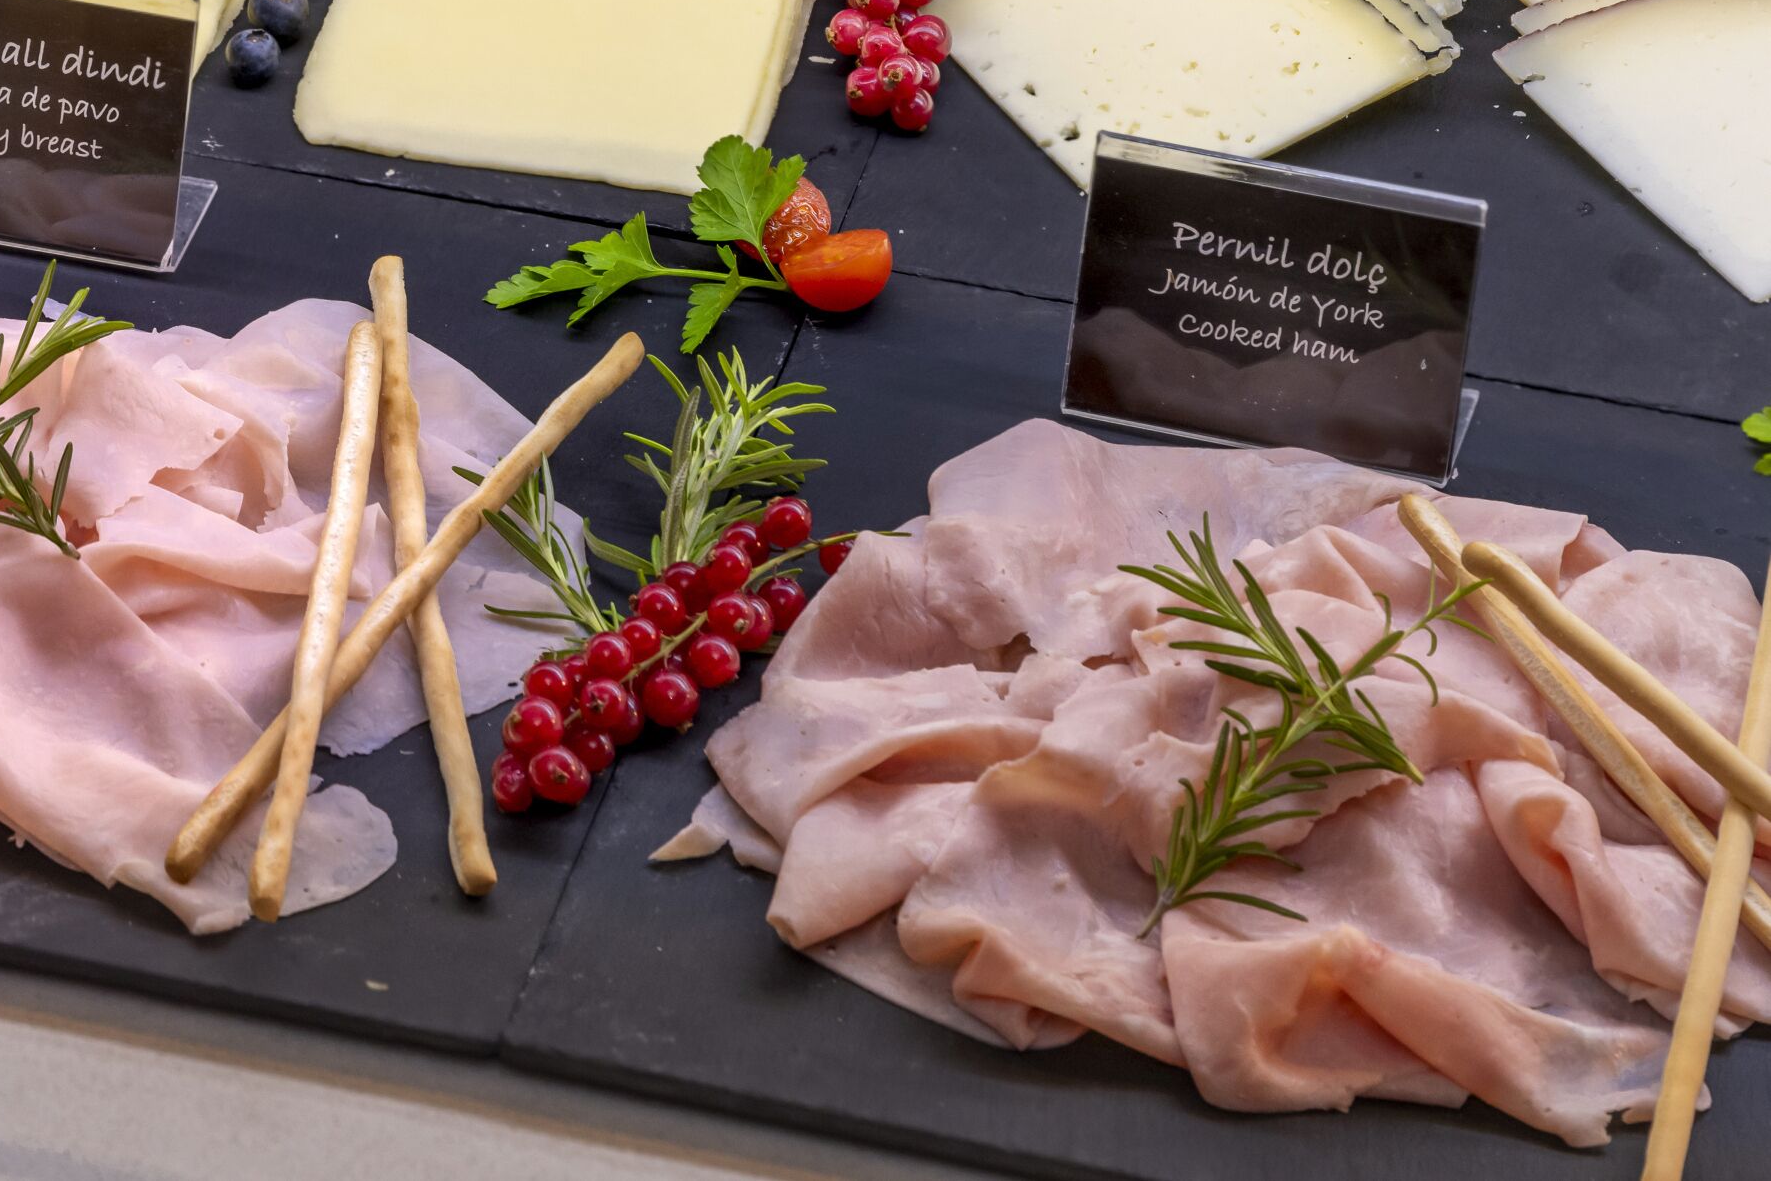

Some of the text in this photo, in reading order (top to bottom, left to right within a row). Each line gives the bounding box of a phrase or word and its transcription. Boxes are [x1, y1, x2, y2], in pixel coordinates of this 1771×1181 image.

[62, 46, 165, 89] dindi
[22, 86, 50, 111] de
[58, 98, 119, 124] pavo
[21, 124, 102, 159] breast
[1173, 222, 1387, 293] Pernil dolç
[1148, 269, 1384, 328] Jamón de York
[1179, 314, 1359, 363] Cooked ham
